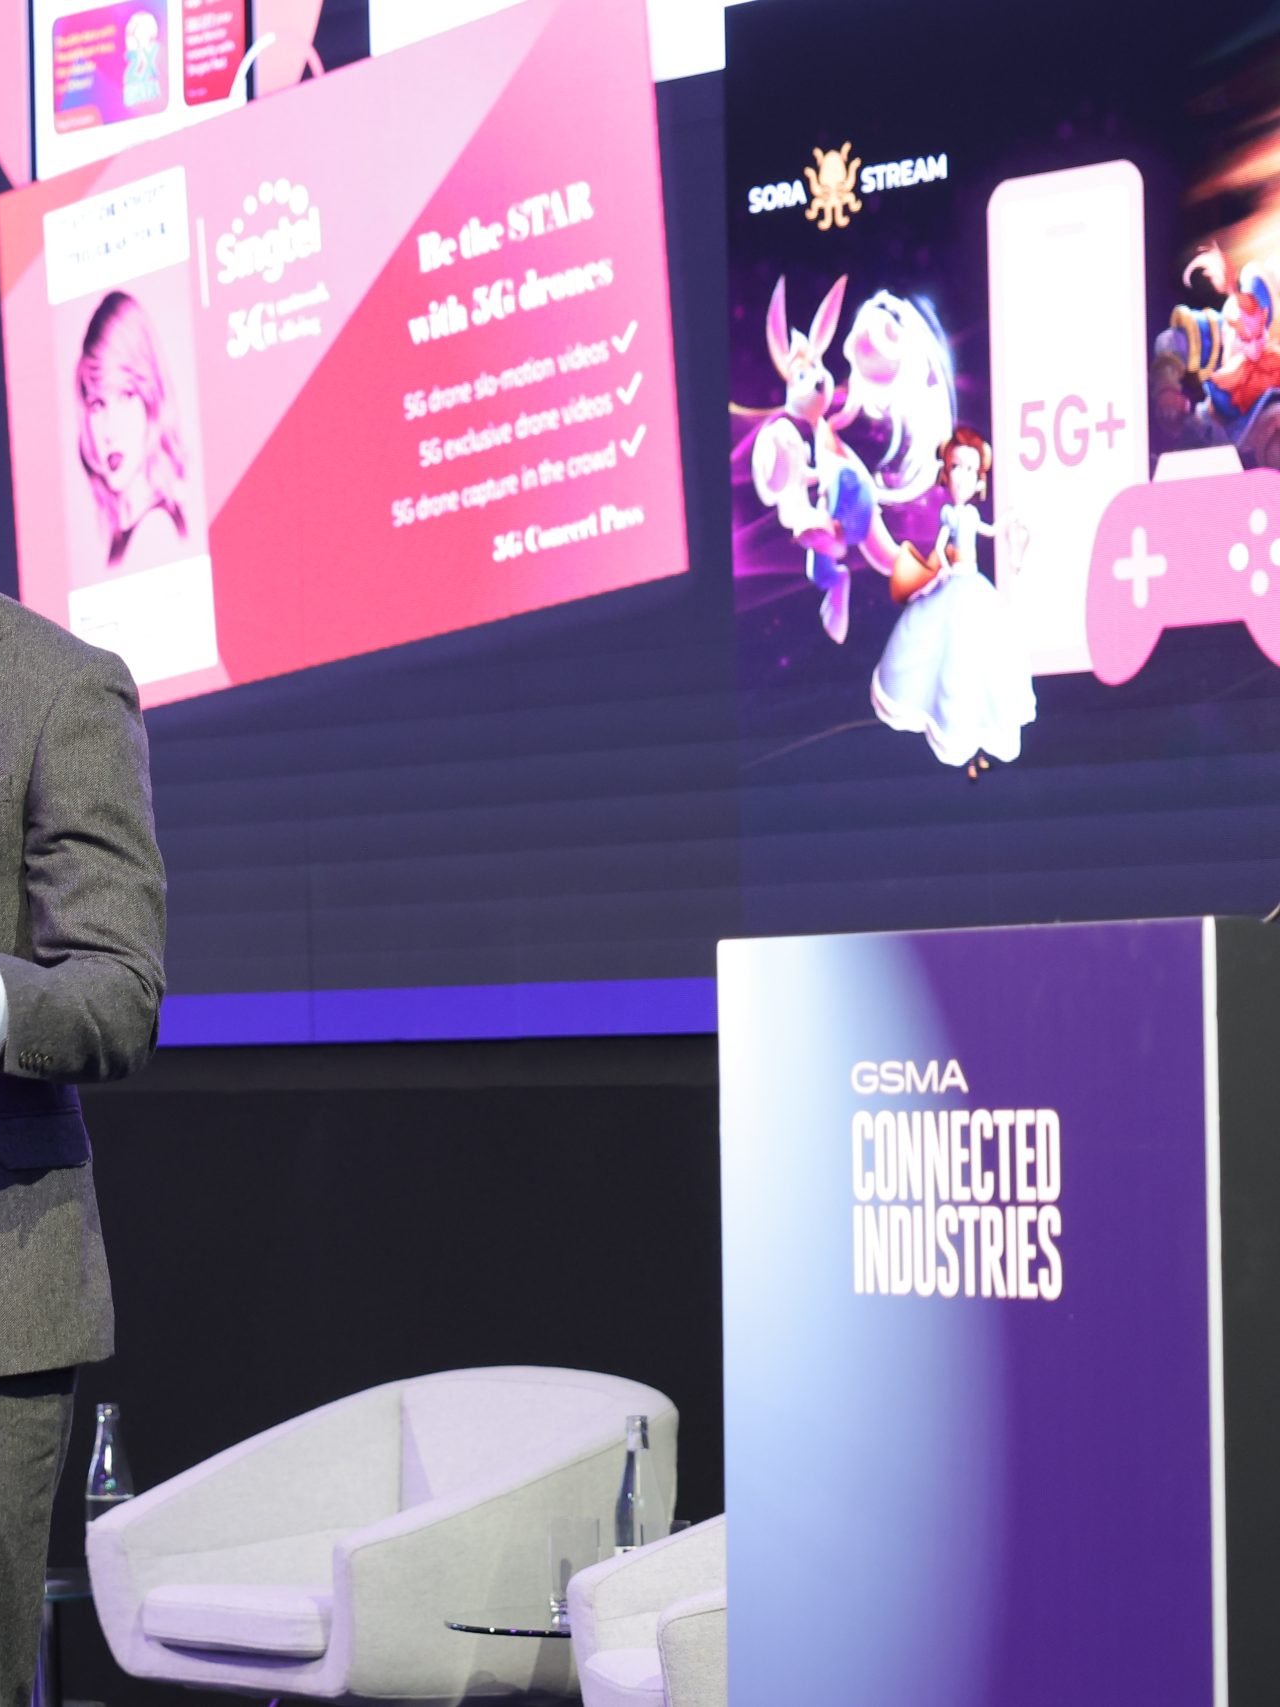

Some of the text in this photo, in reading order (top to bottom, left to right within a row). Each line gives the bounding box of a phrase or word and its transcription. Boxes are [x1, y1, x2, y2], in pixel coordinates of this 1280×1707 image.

[748, 153, 948, 214] SORA STREAM
[216, 206, 321, 284] Singtel
[417, 181, 594, 274] Be the STAR
[408, 258, 614, 345] with 5G drones
[403, 341, 610, 420] 5G drone slo-motion videos
[419, 393, 613, 468] 5G exclusive drone videos
[1019, 394, 1126, 472] 5G+
[391, 440, 617, 528] 5G drone capture in the crowd
[851, 1059, 969, 1095] GSMA
[852, 1109, 1061, 1203] CONNECTED
[853, 1204, 1062, 1300] INDUSTRIES
